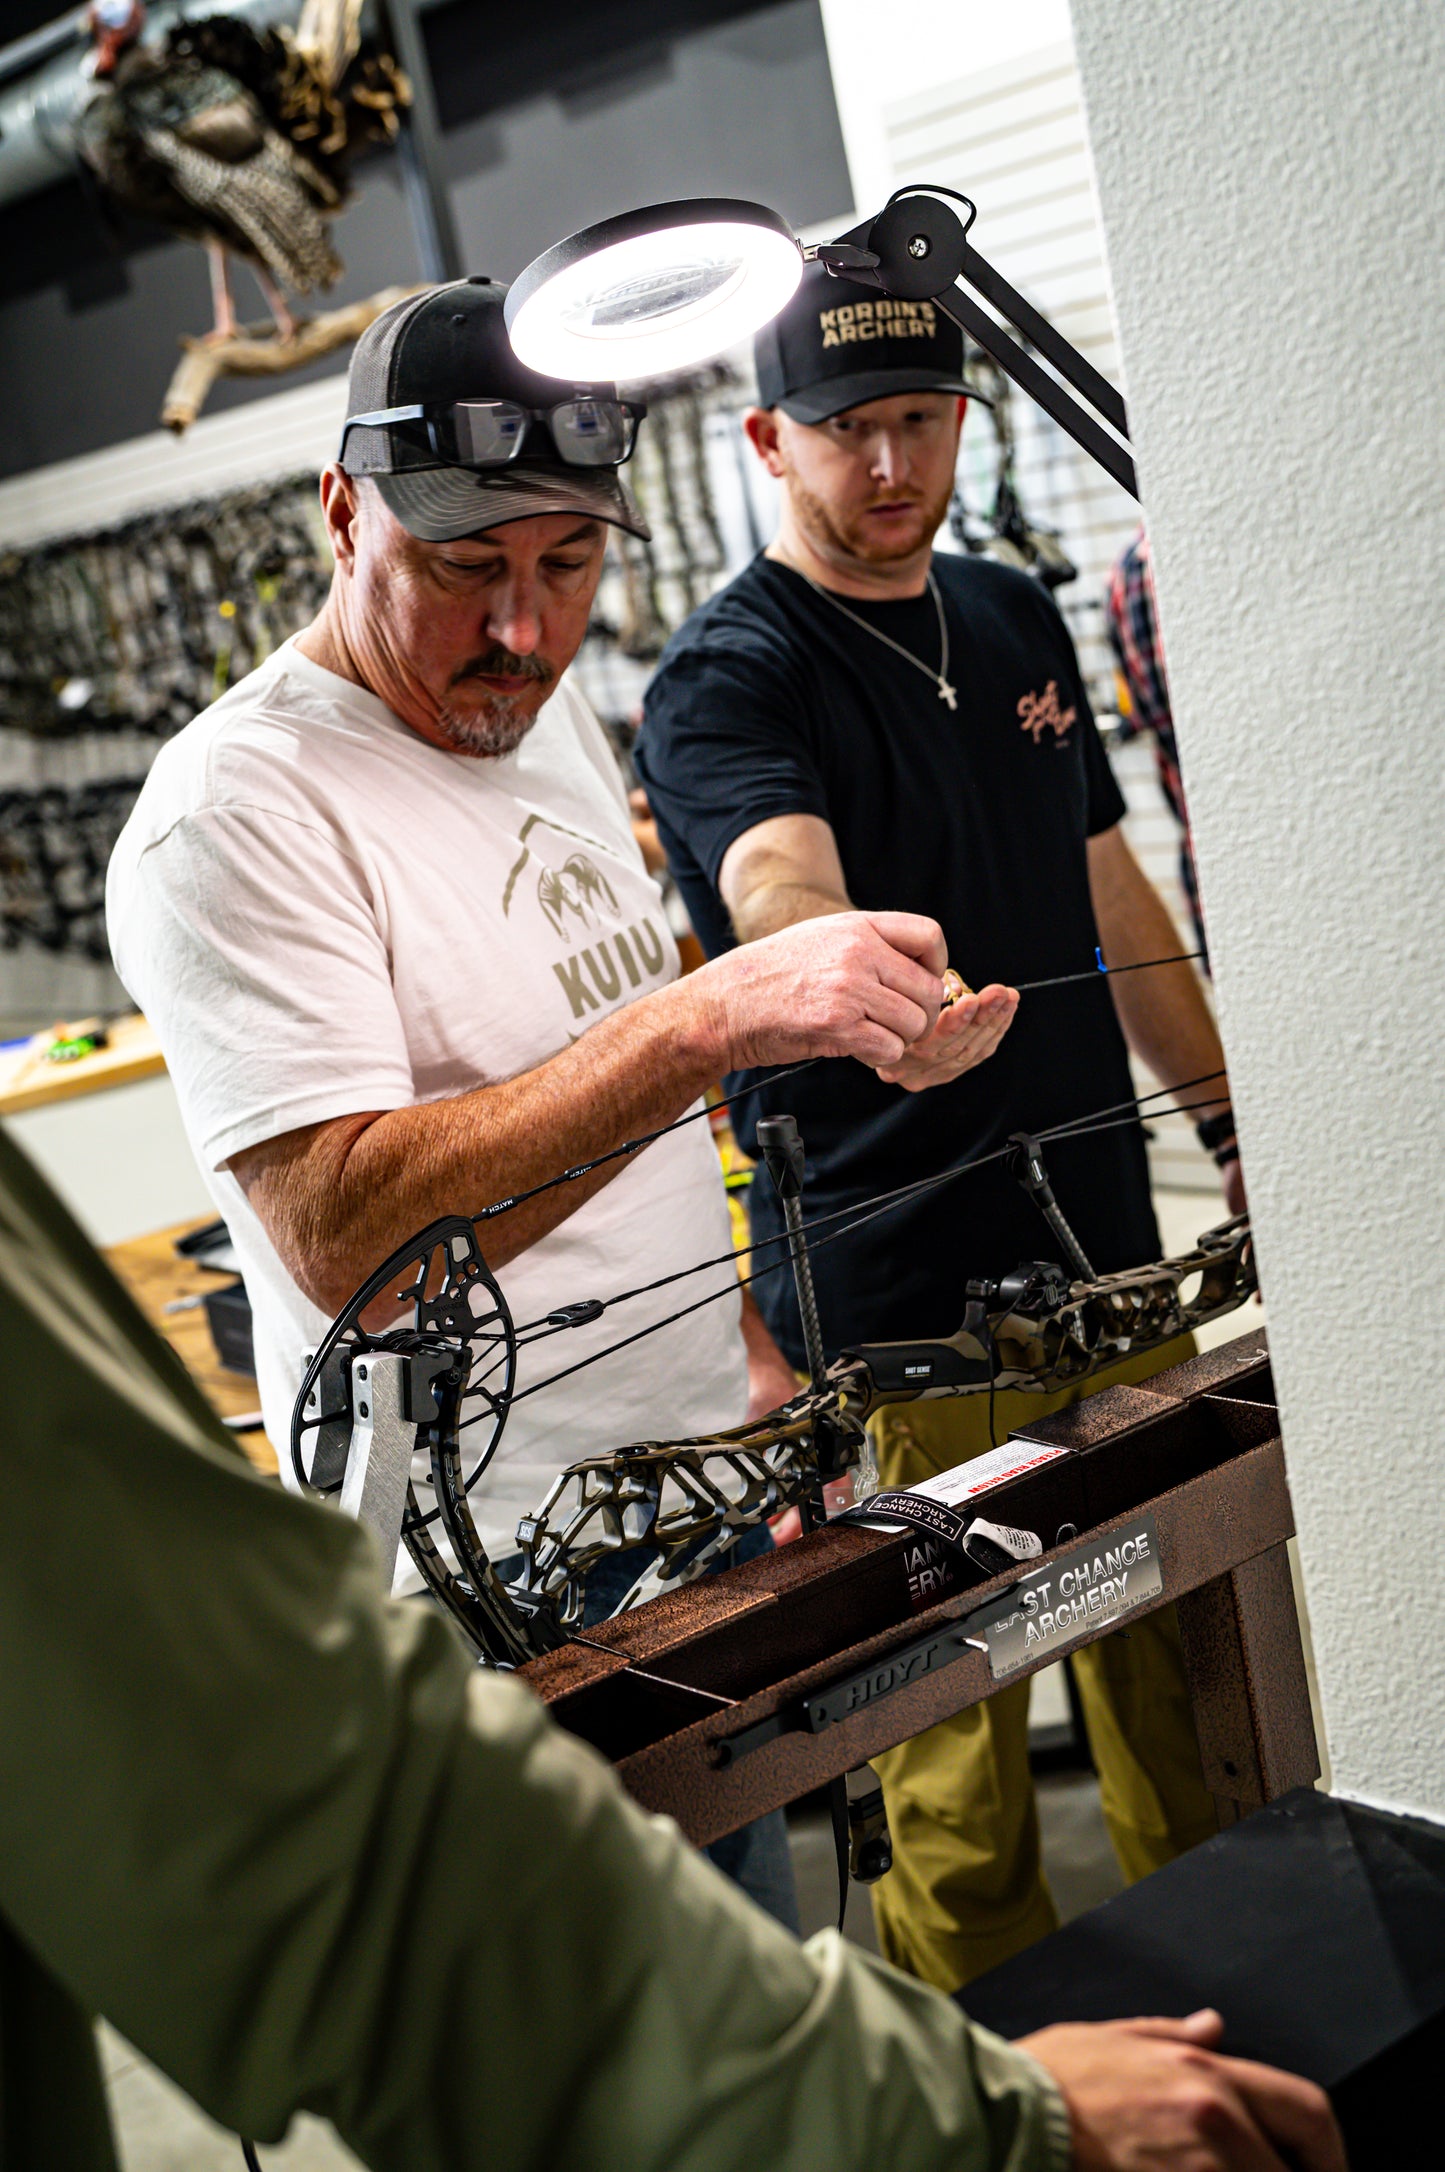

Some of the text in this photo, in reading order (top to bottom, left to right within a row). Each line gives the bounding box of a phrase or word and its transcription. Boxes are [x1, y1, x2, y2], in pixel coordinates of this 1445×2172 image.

[822, 319, 936, 349] ARCHERY
[552, 916, 664, 1019] KUIU
[489, 1199, 513, 1213] MATCH
[968, 1449, 1063, 1494] PLEASE READ BELOW
[874, 1502, 955, 1535] LAST CHANCE
[891, 1498, 947, 1520] ARCHERY
[520, 1525, 532, 1538] SCS
[1059, 1533, 1151, 1597] CHANCE
[1024, 1572, 1128, 1648] ARCHERY
[846, 1644, 939, 1712] HOYT
